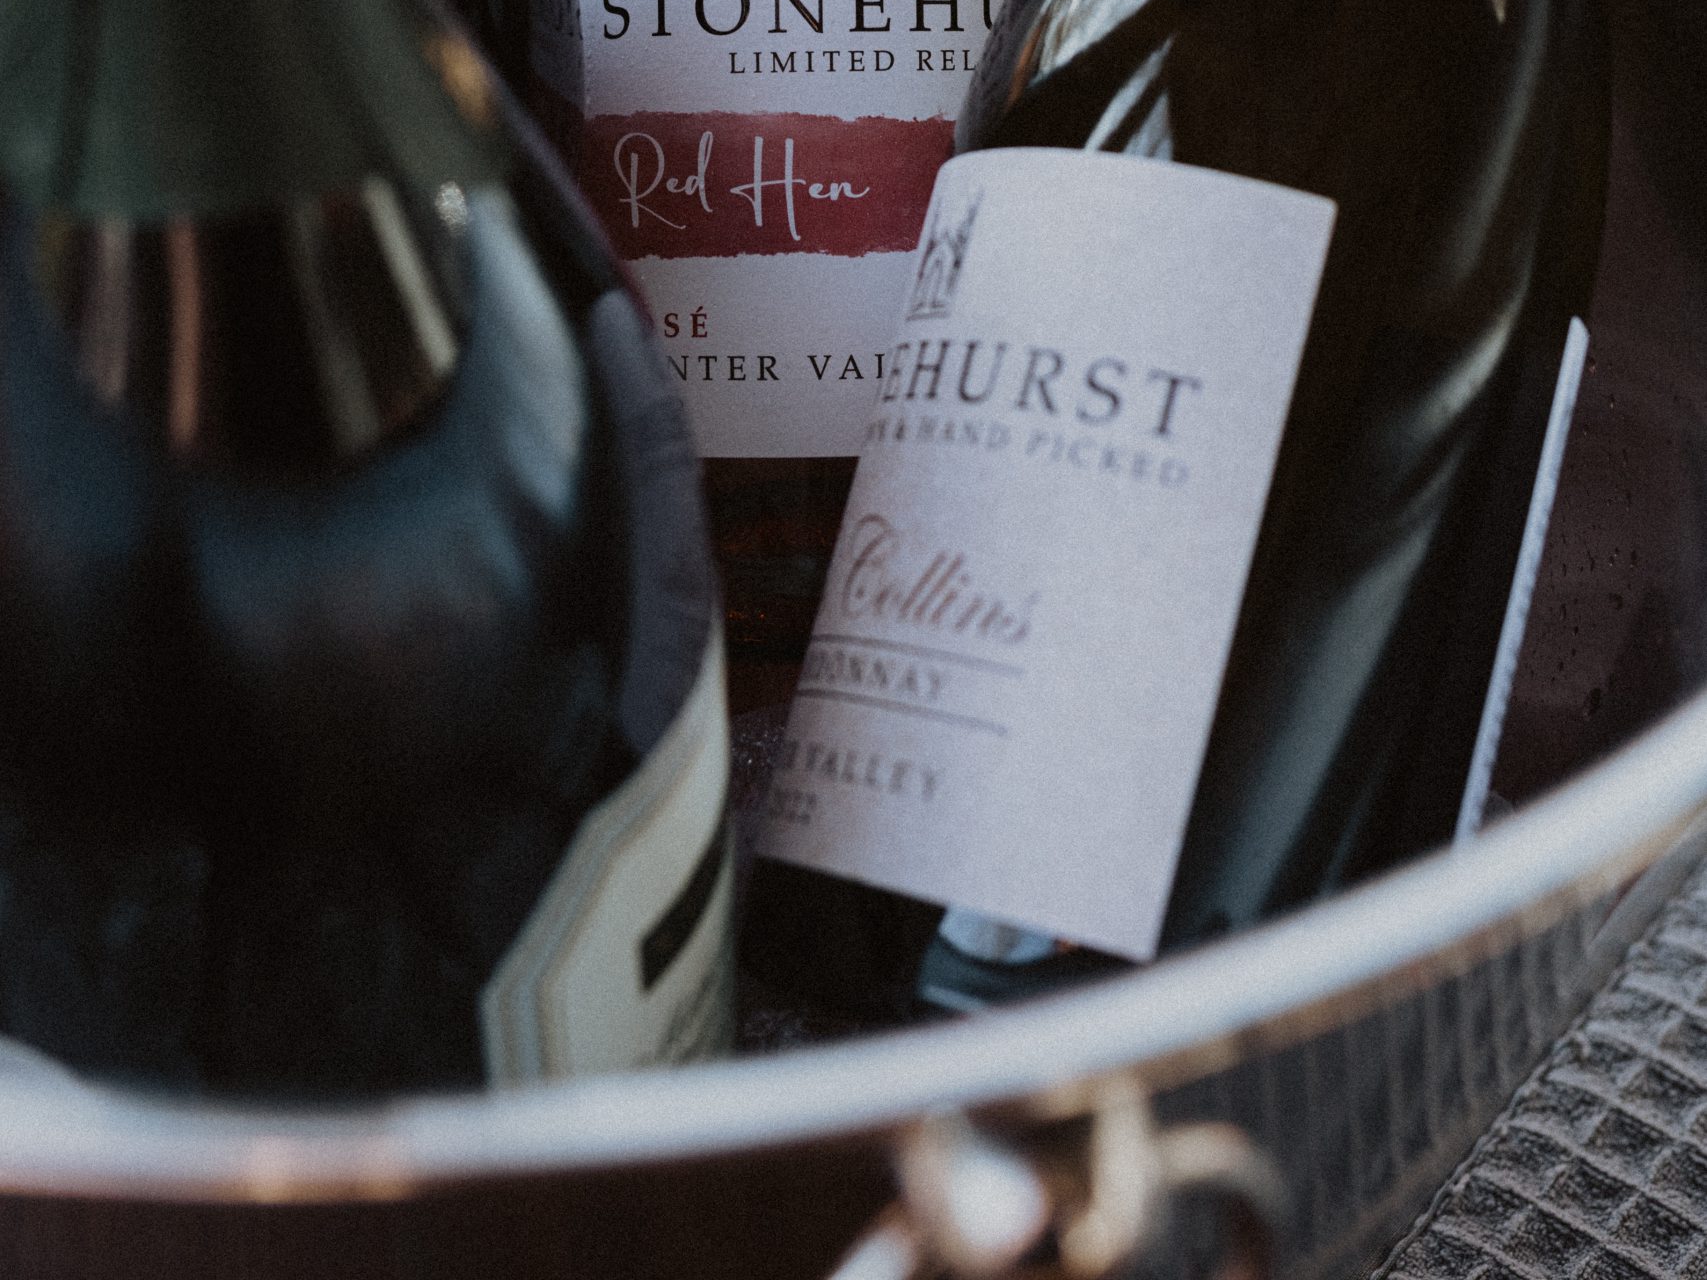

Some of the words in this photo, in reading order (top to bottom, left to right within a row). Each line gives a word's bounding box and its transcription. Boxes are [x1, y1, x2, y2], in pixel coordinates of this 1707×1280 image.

[729, 49, 896, 74] LIMITED
[916, 49, 977, 73] REL
[613, 131, 715, 230] Red
[730, 136, 870, 241] Hen
[663, 306, 709, 338] SÉ
[1025, 428, 1191, 489] PICKED
